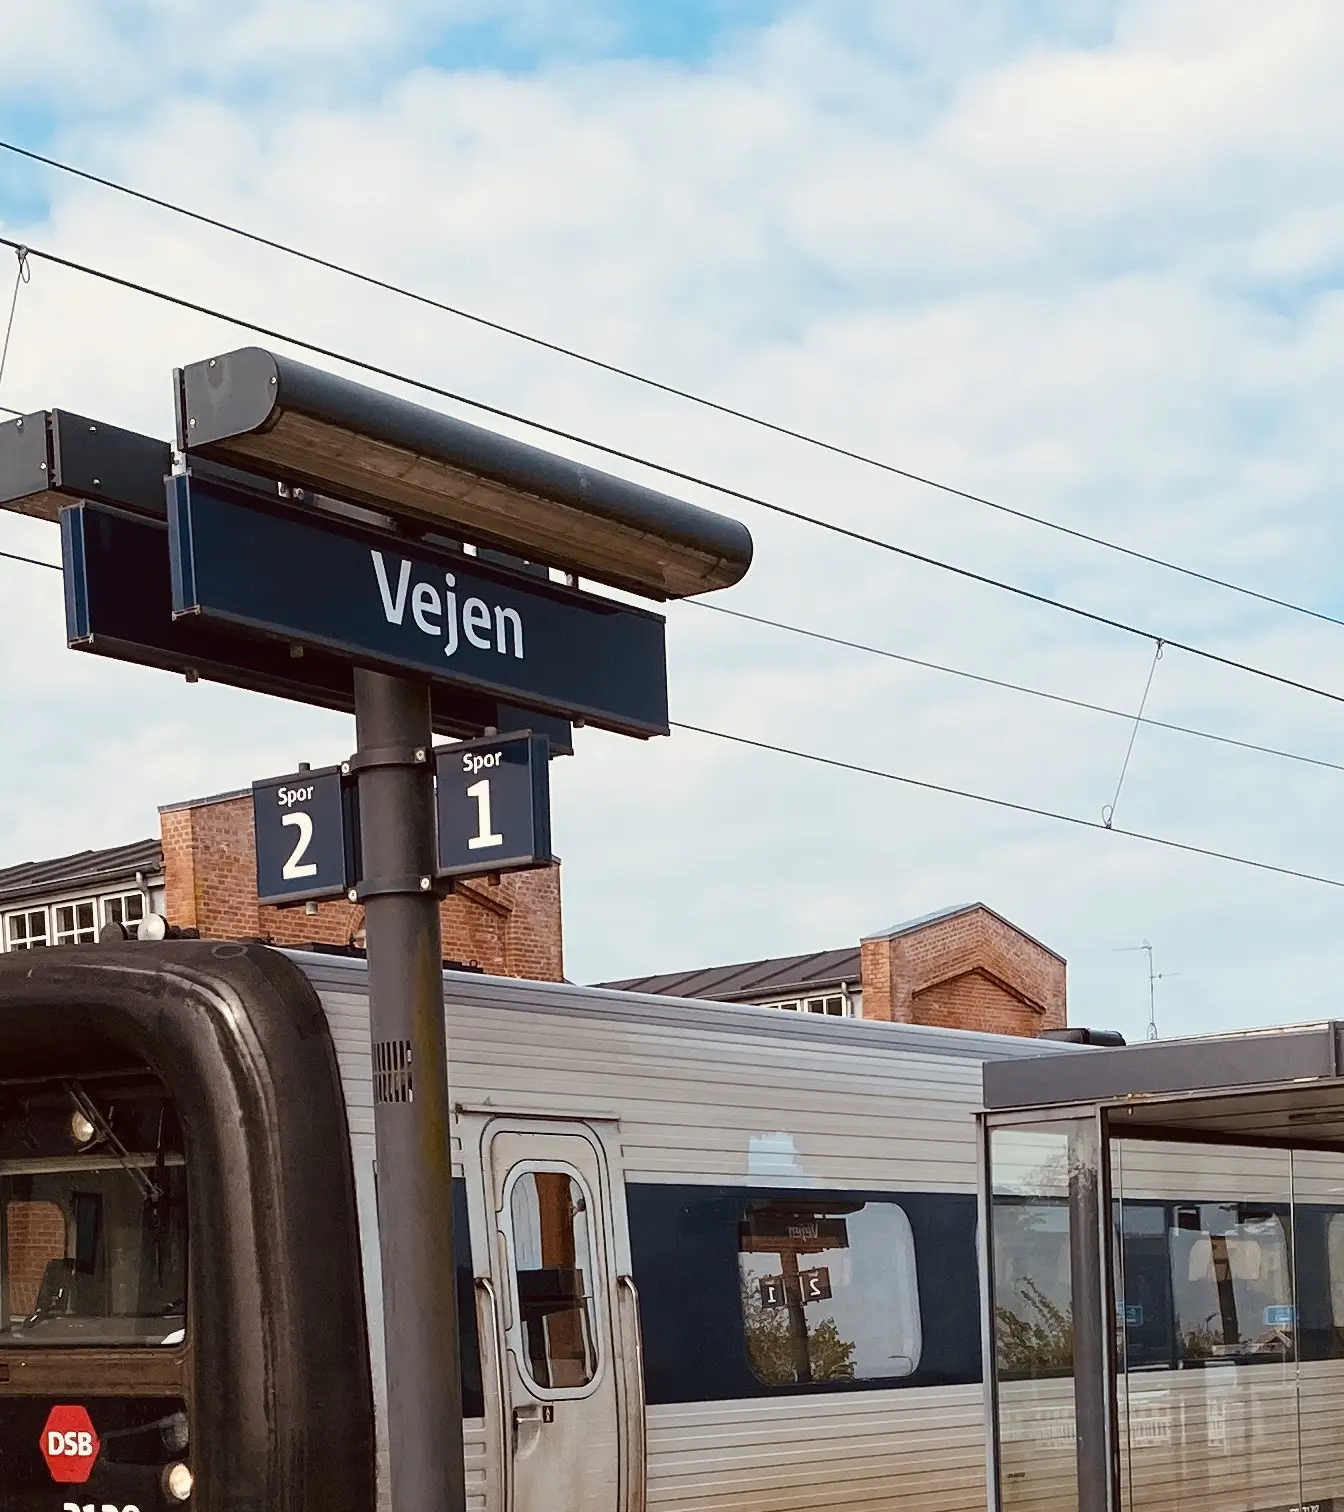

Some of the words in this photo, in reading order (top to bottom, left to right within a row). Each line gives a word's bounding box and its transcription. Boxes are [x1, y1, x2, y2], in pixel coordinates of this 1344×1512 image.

[370, 550, 524, 659] Vejen
[462, 750, 503, 775] Spor
[277, 785, 315, 808] Spor
[466, 779, 503, 850] 1
[281, 811, 318, 881] 2
[47, 1431, 94, 1456] DSB
